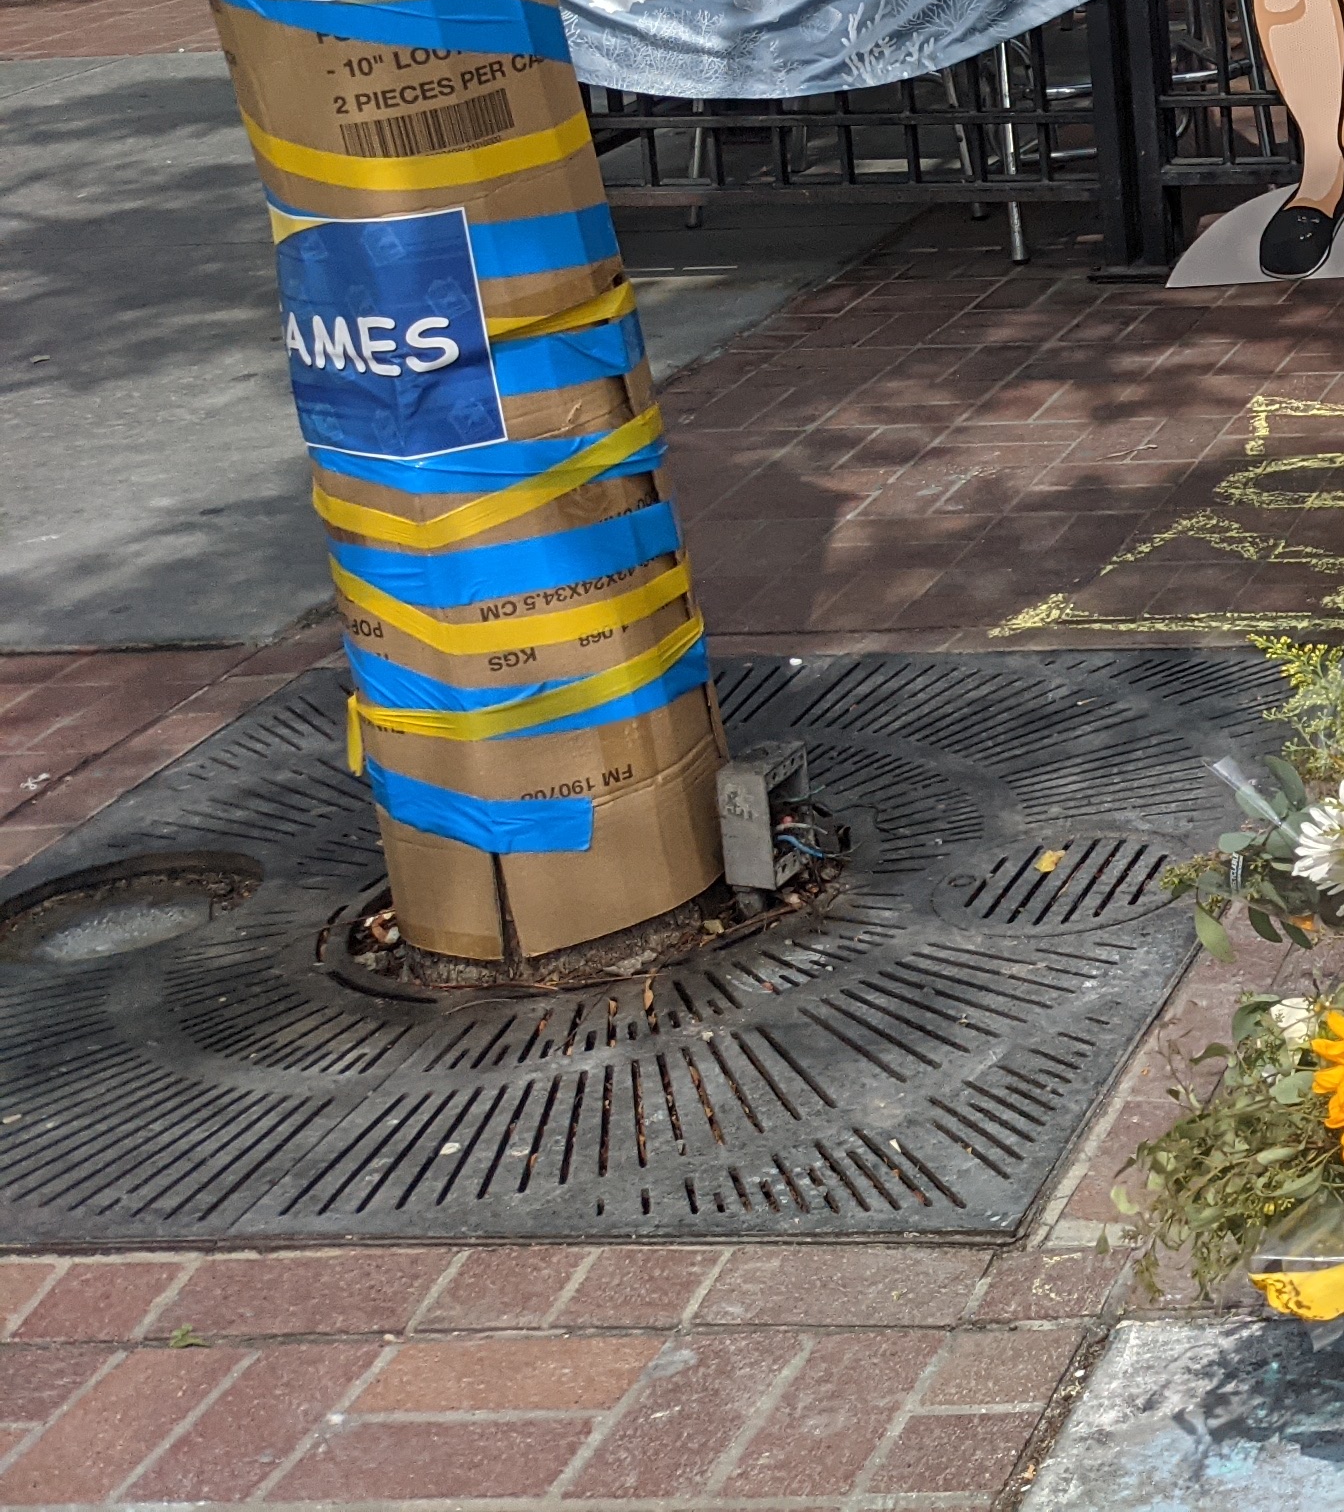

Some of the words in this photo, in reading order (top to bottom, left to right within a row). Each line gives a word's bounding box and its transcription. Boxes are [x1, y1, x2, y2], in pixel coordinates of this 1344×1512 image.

[333, 96, 349, 115] 2
[354, 77, 456, 114] PIECES
[460, 60, 507, 91] PER
[286, 316, 460, 377] AMES
[479, 600, 518, 624] CM
[488, 646, 538, 672] KGS
[601, 763, 634, 788] FM
